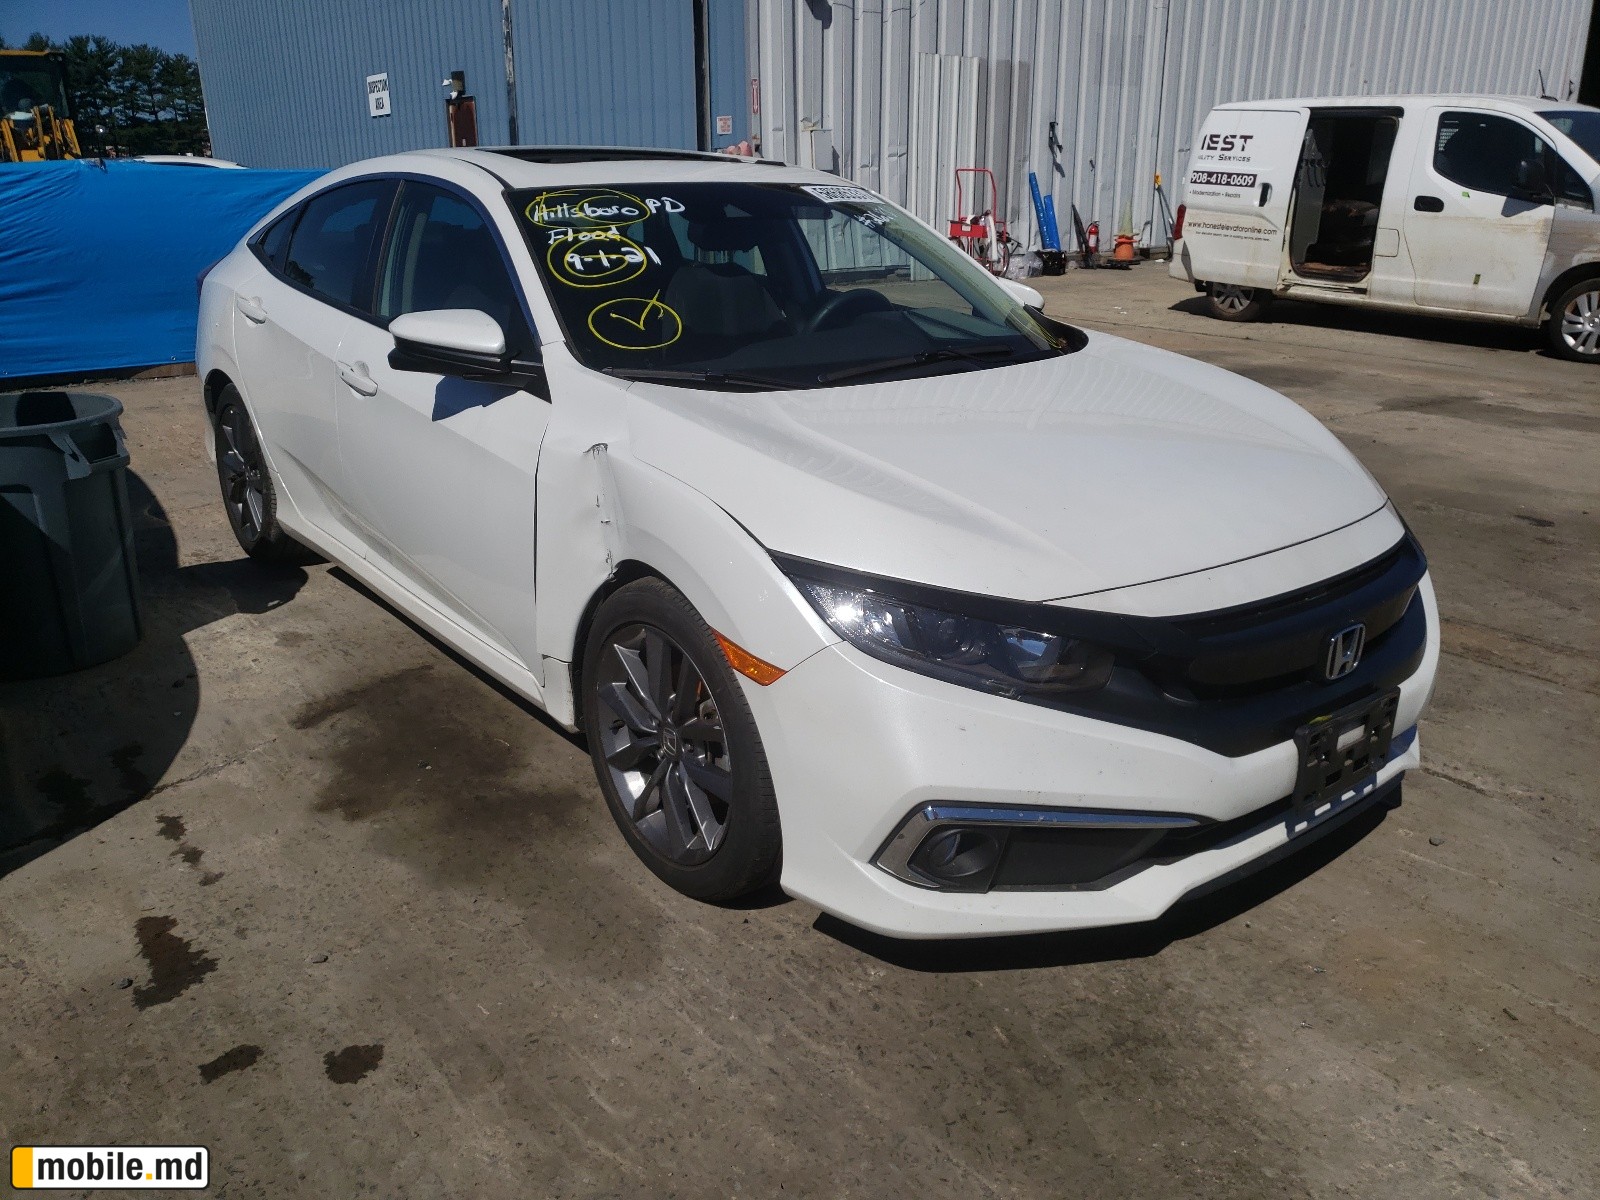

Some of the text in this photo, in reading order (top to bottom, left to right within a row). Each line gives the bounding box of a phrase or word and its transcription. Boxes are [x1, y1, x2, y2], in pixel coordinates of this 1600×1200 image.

[1191, 172, 1254, 186] 908-418-0609
[534, 196, 686, 222] Hillsboro PD
[546, 225, 621, 244] Flood
[566, 246, 662, 271] 9-1-21
